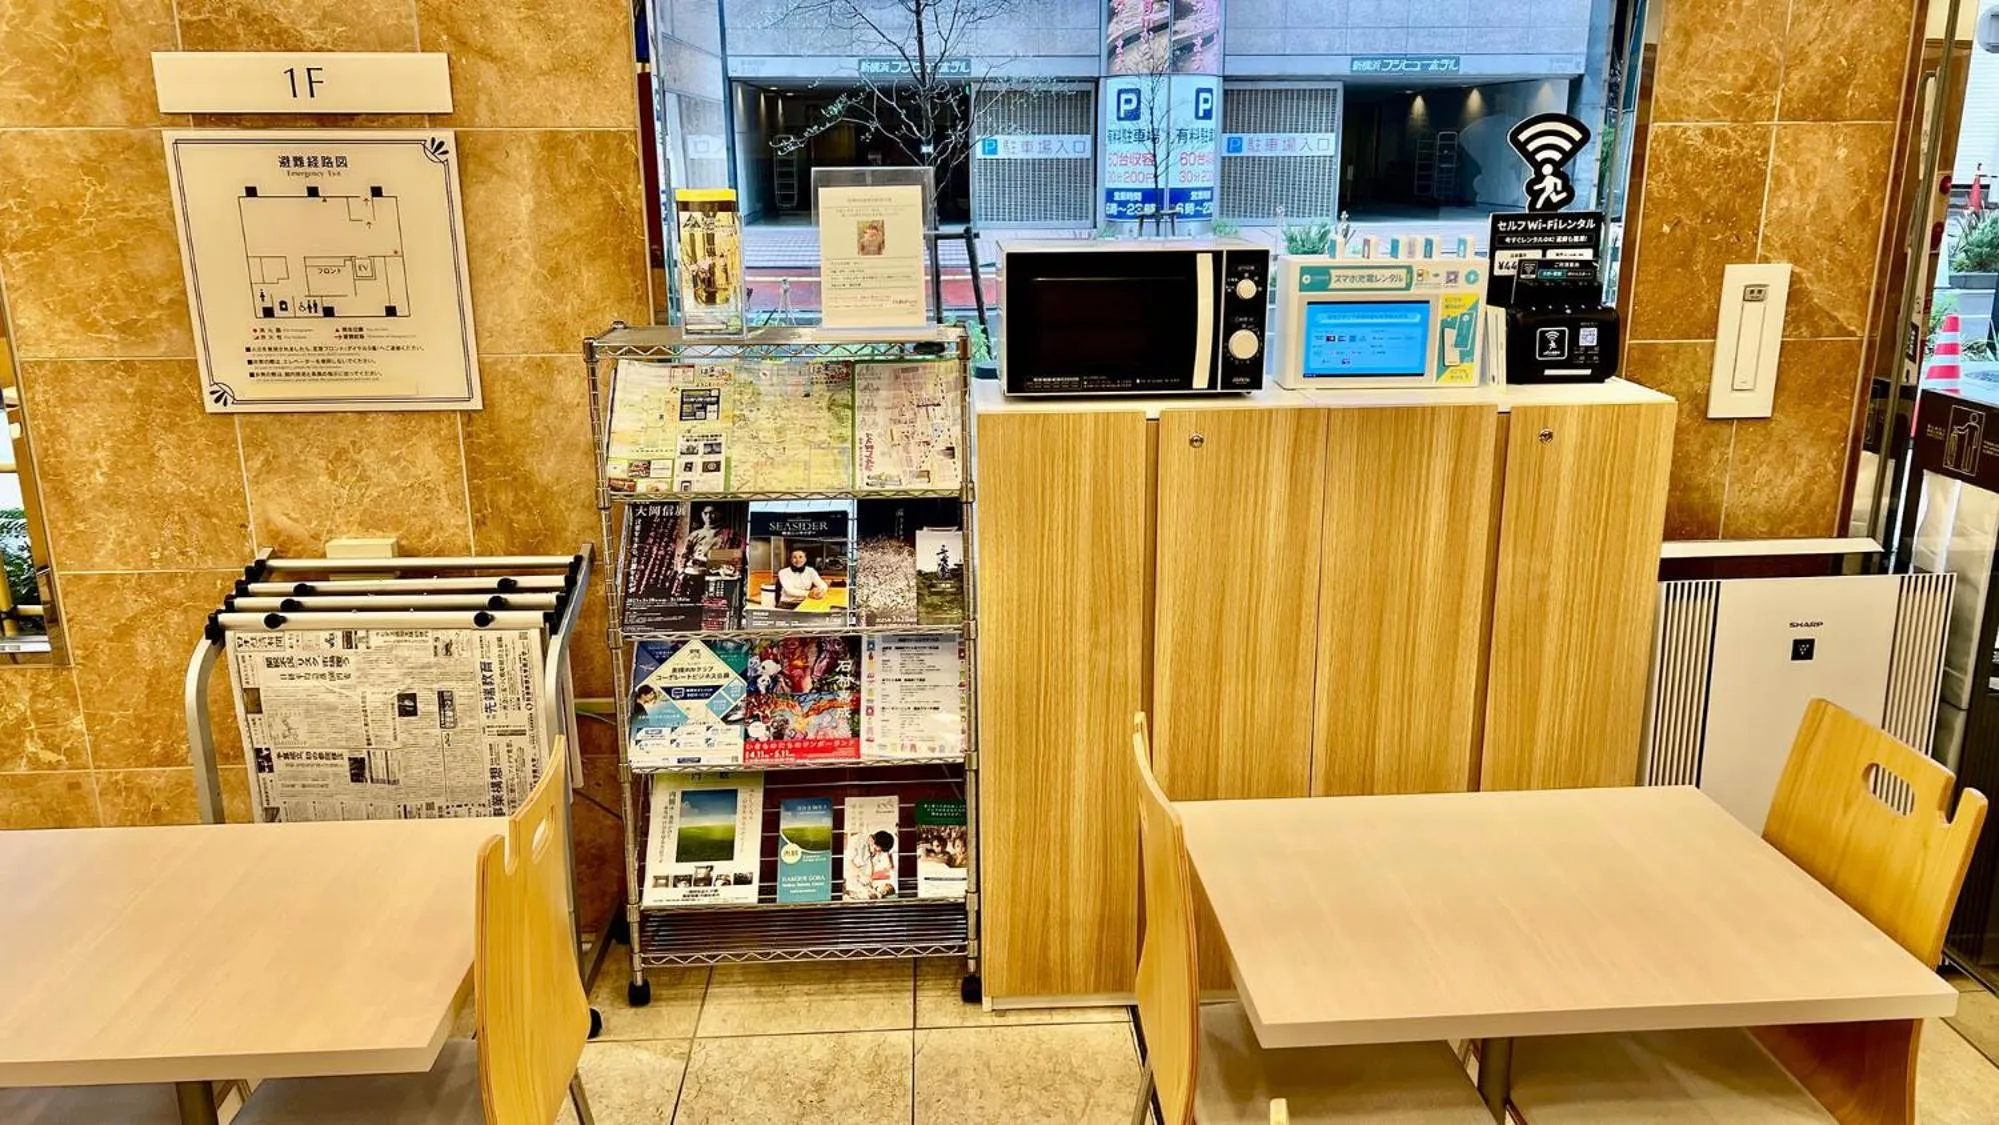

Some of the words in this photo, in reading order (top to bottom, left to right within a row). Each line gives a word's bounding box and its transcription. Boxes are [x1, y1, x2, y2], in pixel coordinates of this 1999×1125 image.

[283, 67, 324, 98] 1F
[1118, 93, 1138, 119] P
[1199, 93, 1212, 118] P
[1003, 139, 1086, 154] 駐車場入口
[1248, 137, 1330, 152] 駐車場入口
[279, 155, 347, 168] 避難経路図
[769, 520, 829, 532] SEASIDER
[1789, 621, 1824, 629] SHARP
